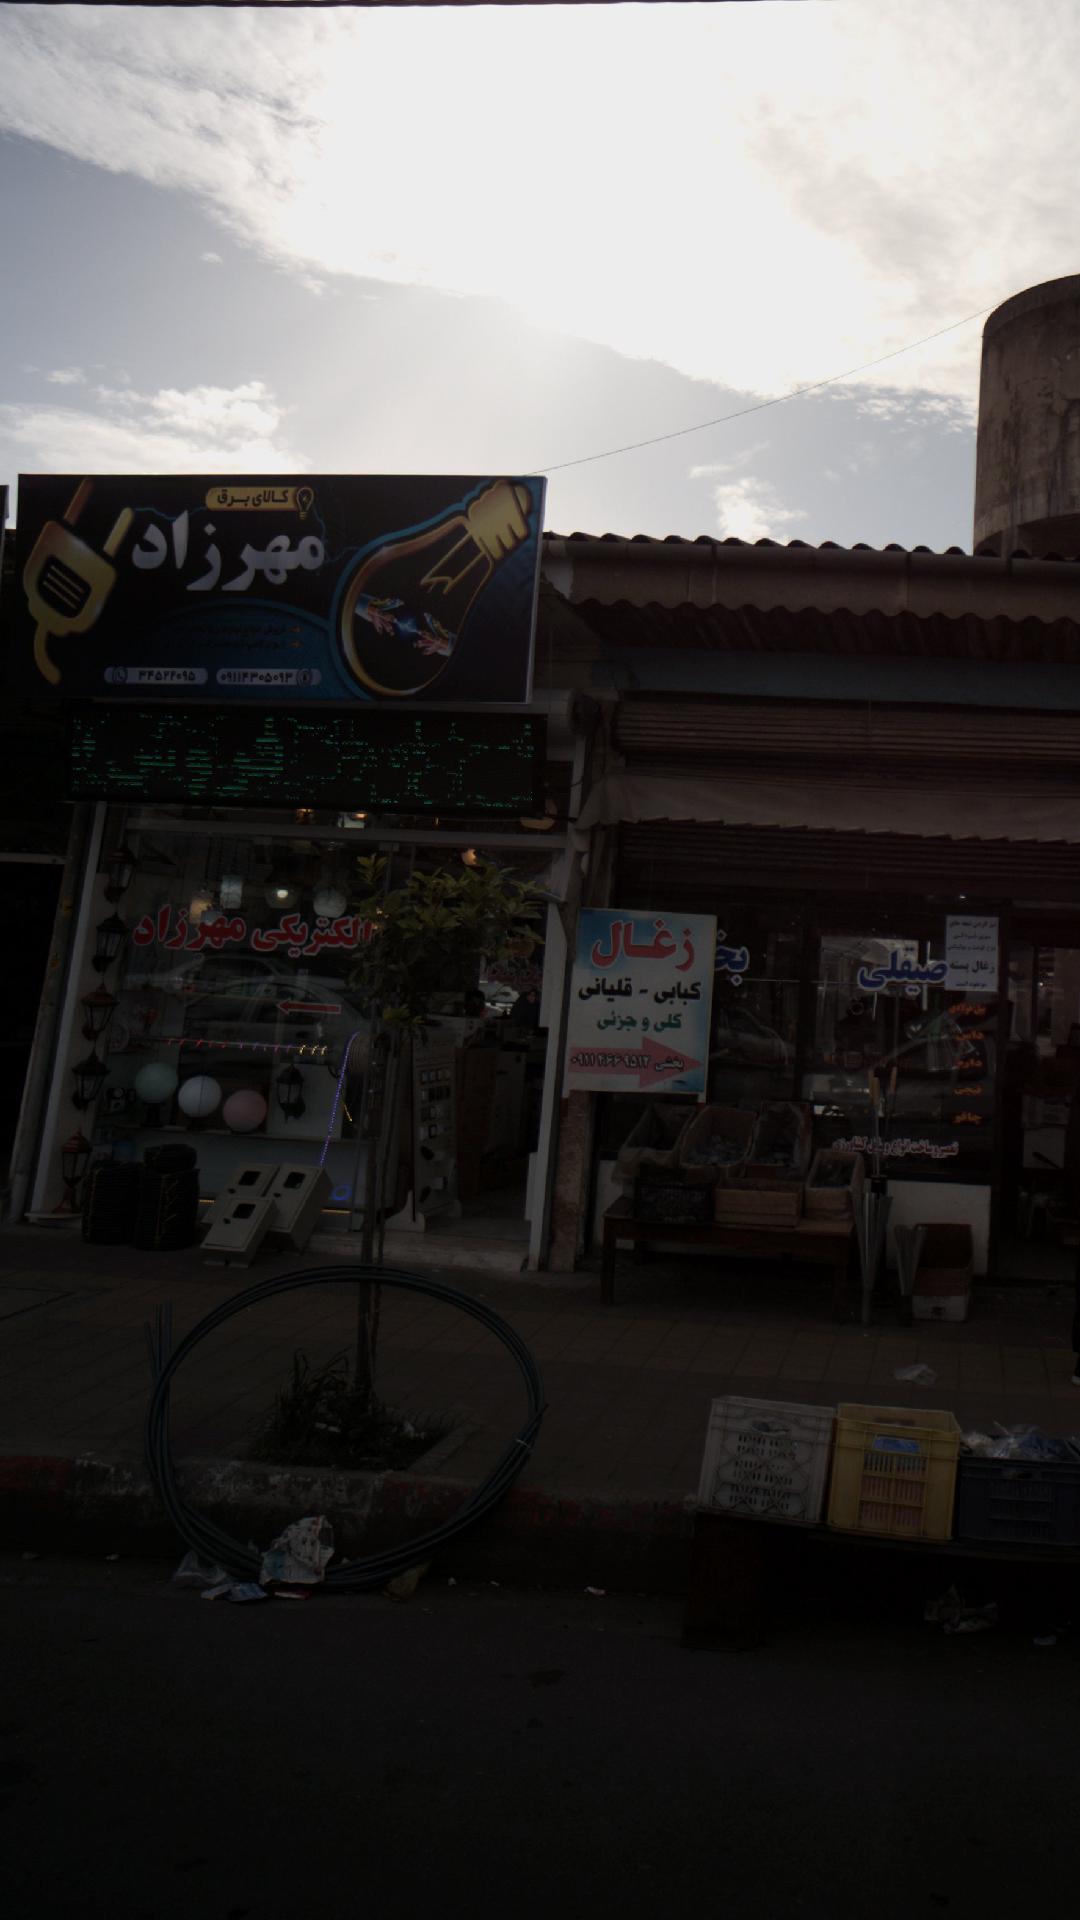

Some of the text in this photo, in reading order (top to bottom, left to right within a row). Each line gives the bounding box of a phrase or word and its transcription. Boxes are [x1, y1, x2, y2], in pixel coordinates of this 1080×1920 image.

[217, 488, 289, 507] کالای برق
[131, 509, 325, 592] مهرزاد
[131, 903, 247, 952] مهرزاد
[591, 918, 697, 973] زغال
[857, 945, 949, 997] صیقلی
[578, 977, 633, 1002] قلیانی
[654, 981, 702, 1005] کبابی
[641, 1016, 650, 1032] و
[653, 1012, 683, 1033] کلی
